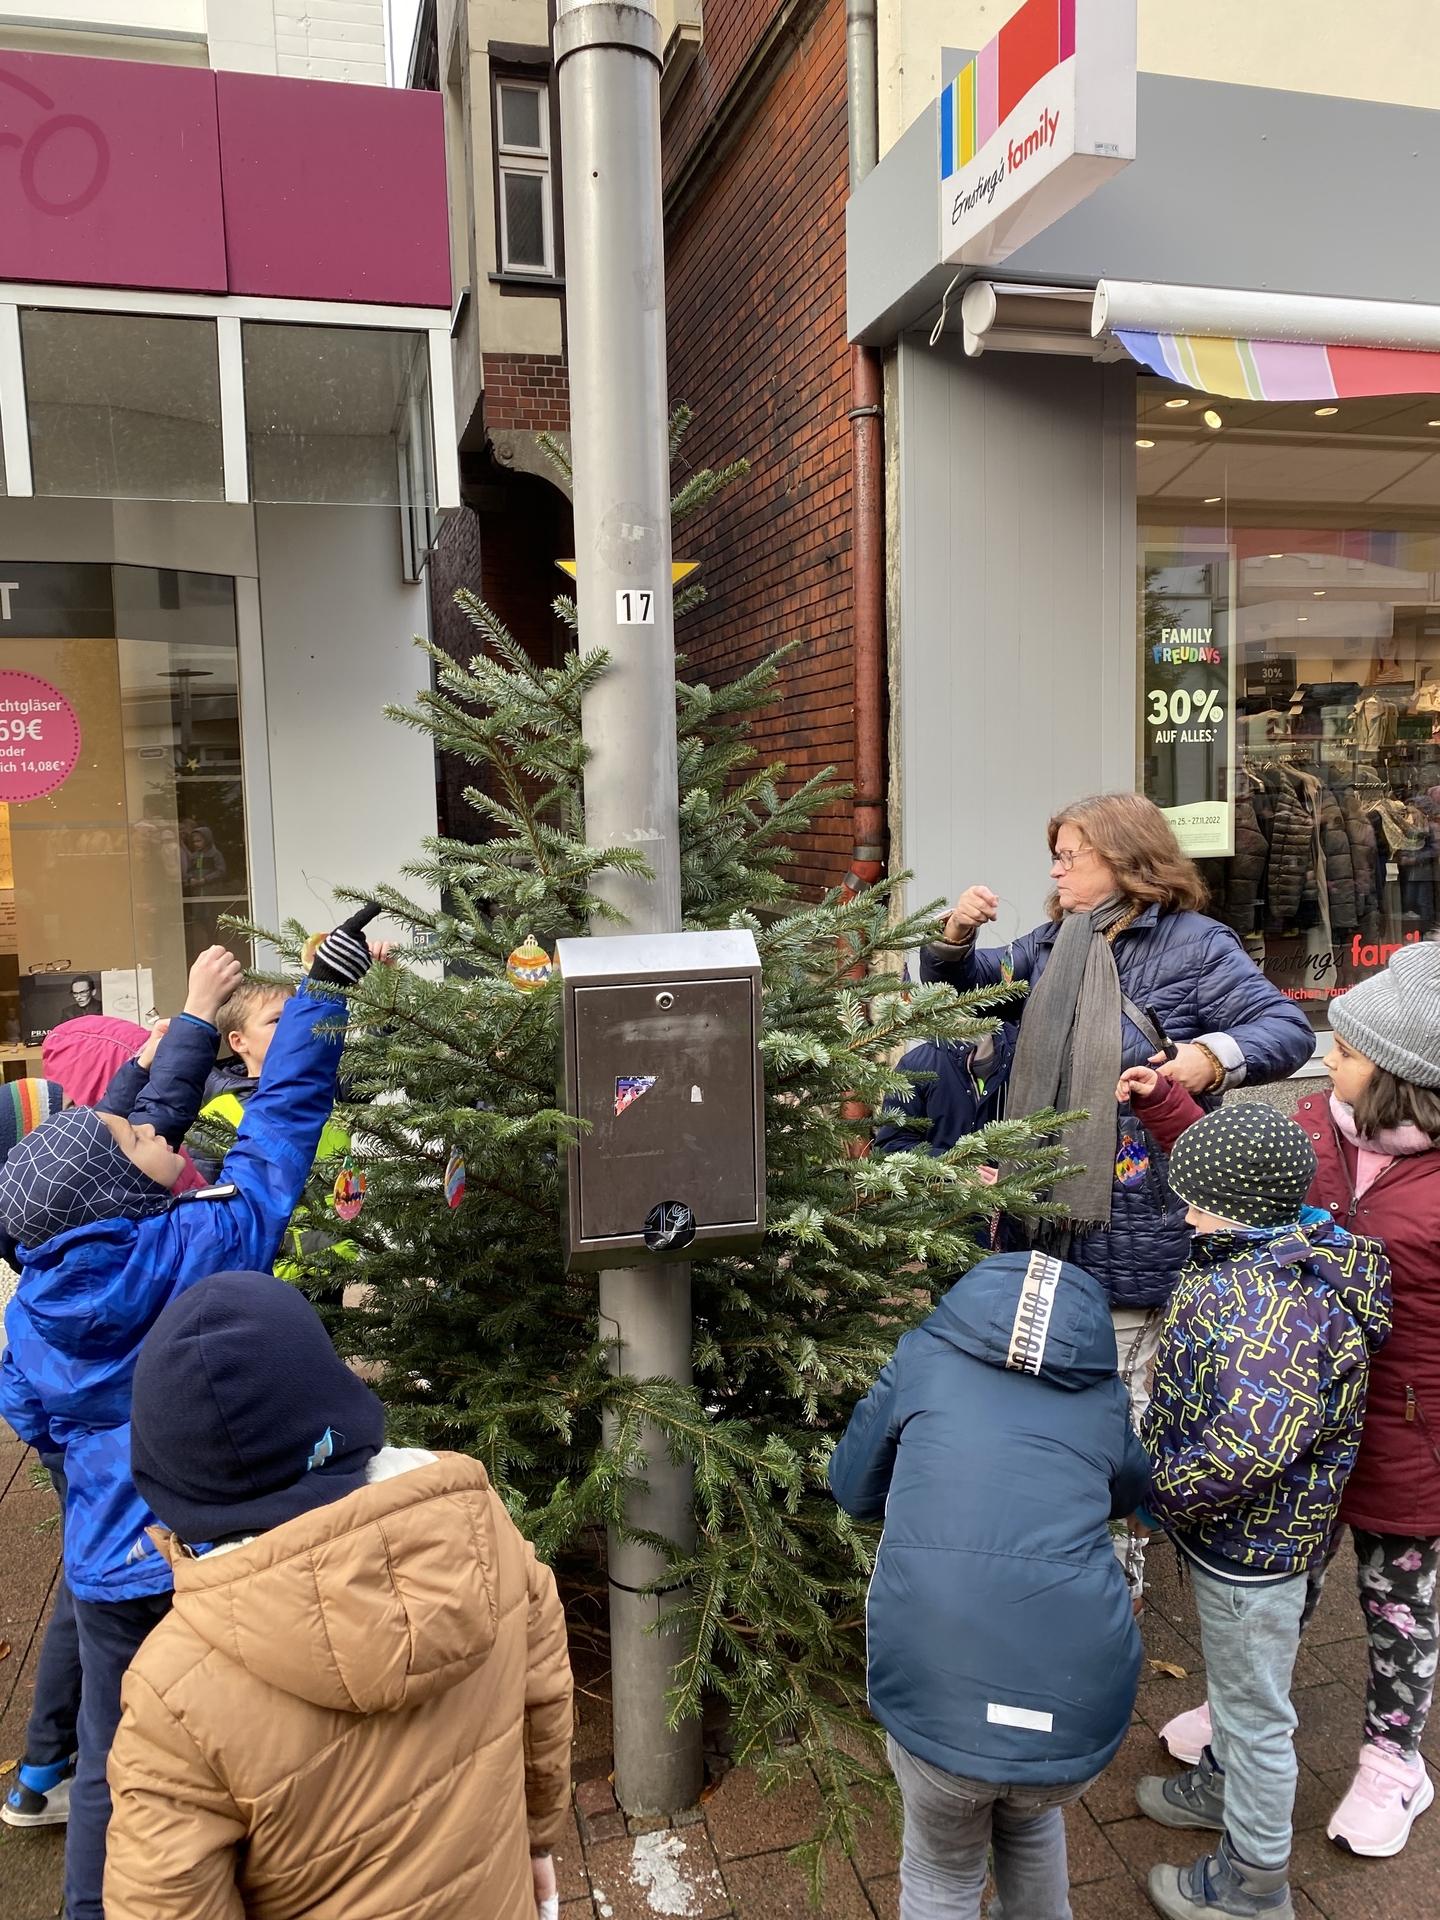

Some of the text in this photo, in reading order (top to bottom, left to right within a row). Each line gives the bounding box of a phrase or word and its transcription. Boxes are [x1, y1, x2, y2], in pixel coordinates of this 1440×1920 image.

[951, 107, 1060, 226] Ernsting's family
[622, 592, 651, 621] 17
[1161, 627, 1212, 644] FAMILY
[1152, 646, 1221, 665] FREUDAYS
[1261, 667, 1283, 679] 30%
[1147, 688, 1224, 725] 30%
[1155, 730, 1178, 743] AUF
[0, 745, 25, 757] oder
